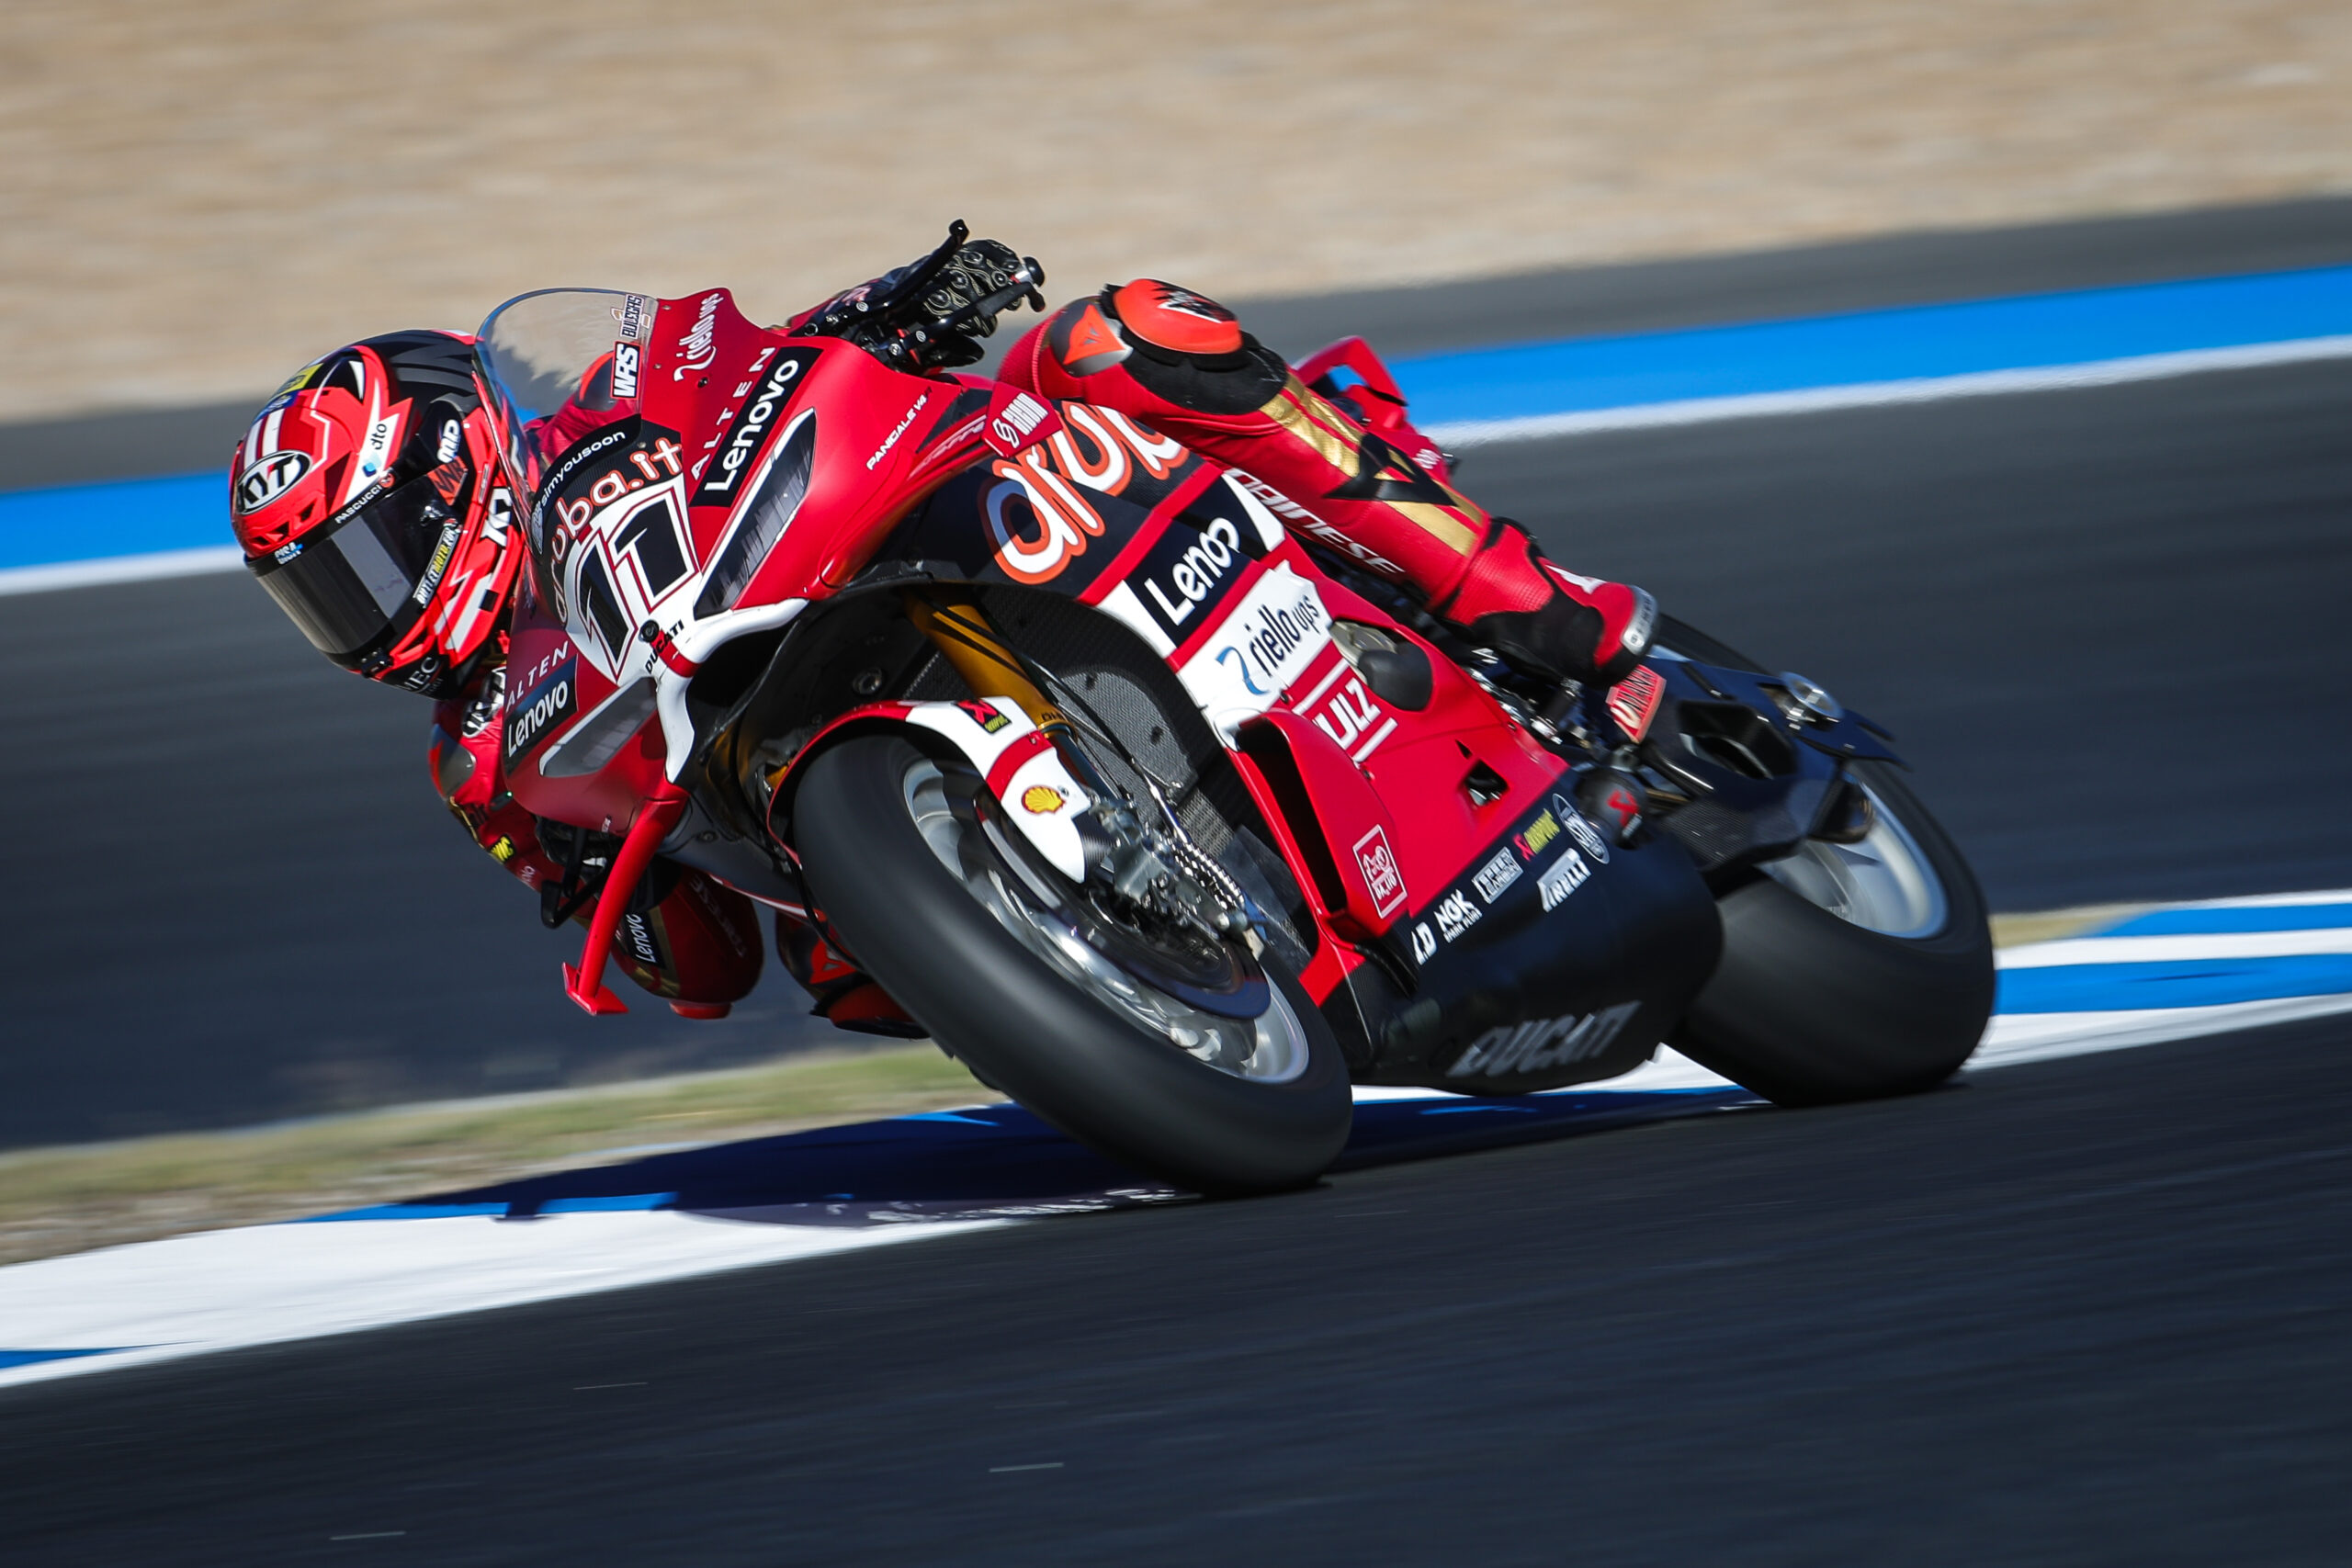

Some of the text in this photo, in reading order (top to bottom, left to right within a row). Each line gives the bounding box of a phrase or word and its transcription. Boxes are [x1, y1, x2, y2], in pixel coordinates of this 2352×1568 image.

[614, 344, 639, 397] WRS
[691, 347, 775, 480] ALTEN
[705, 359, 799, 491] Lenovo
[866, 408, 917, 471] PANIGALE
[238, 455, 300, 506] KYT
[335, 485, 383, 525] PASCUCCI
[540, 432, 626, 508] simyousoon
[1224, 468, 1406, 574] DAINESE
[575, 486, 699, 678] 11
[645, 619, 685, 675] DUCATI
[1244, 594, 1321, 678] riello ups
[506, 640, 569, 713] ALTEN
[1311, 676, 1382, 750] ULZ
[508, 681, 569, 758] Lenovo
[1433, 888, 1476, 934] NGK
[1536, 848, 1592, 913] PIRELLI
[1445, 999, 1643, 1078] DUCATI
